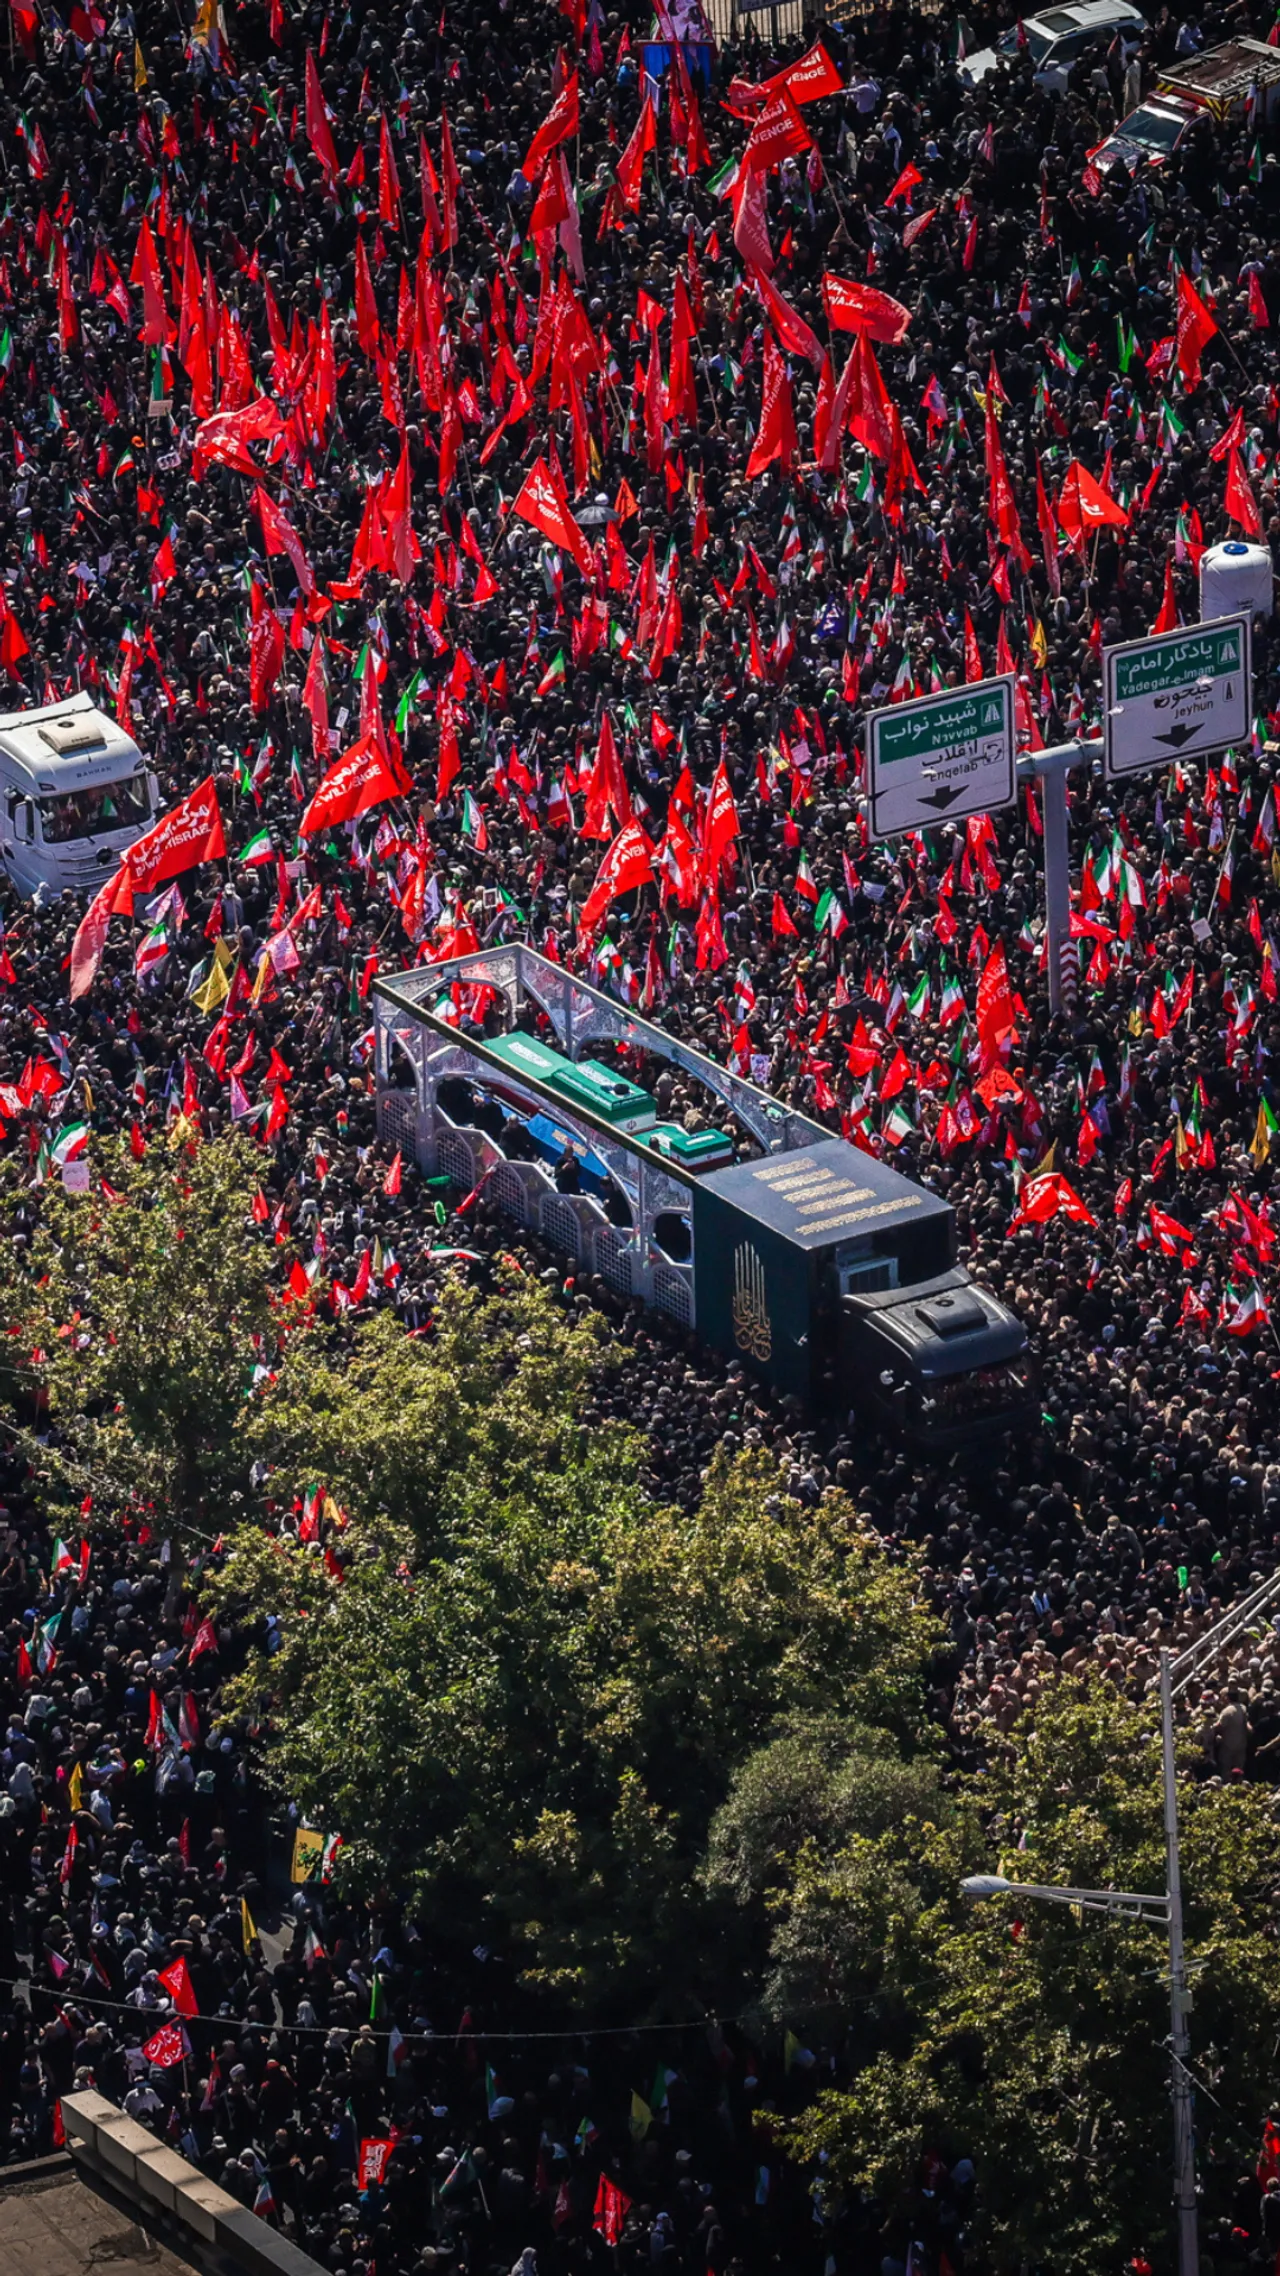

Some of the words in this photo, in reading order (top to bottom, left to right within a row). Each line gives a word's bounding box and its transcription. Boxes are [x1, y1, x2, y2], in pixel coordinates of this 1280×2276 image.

[1128, 651, 1162, 683] امام
[1164, 640, 1213, 672] یادگار
[933, 701, 977, 728] شهید
[884, 716, 930, 744] نواب
[931, 724, 978, 745] Navvab
[921, 739, 978, 770] انقلاب
